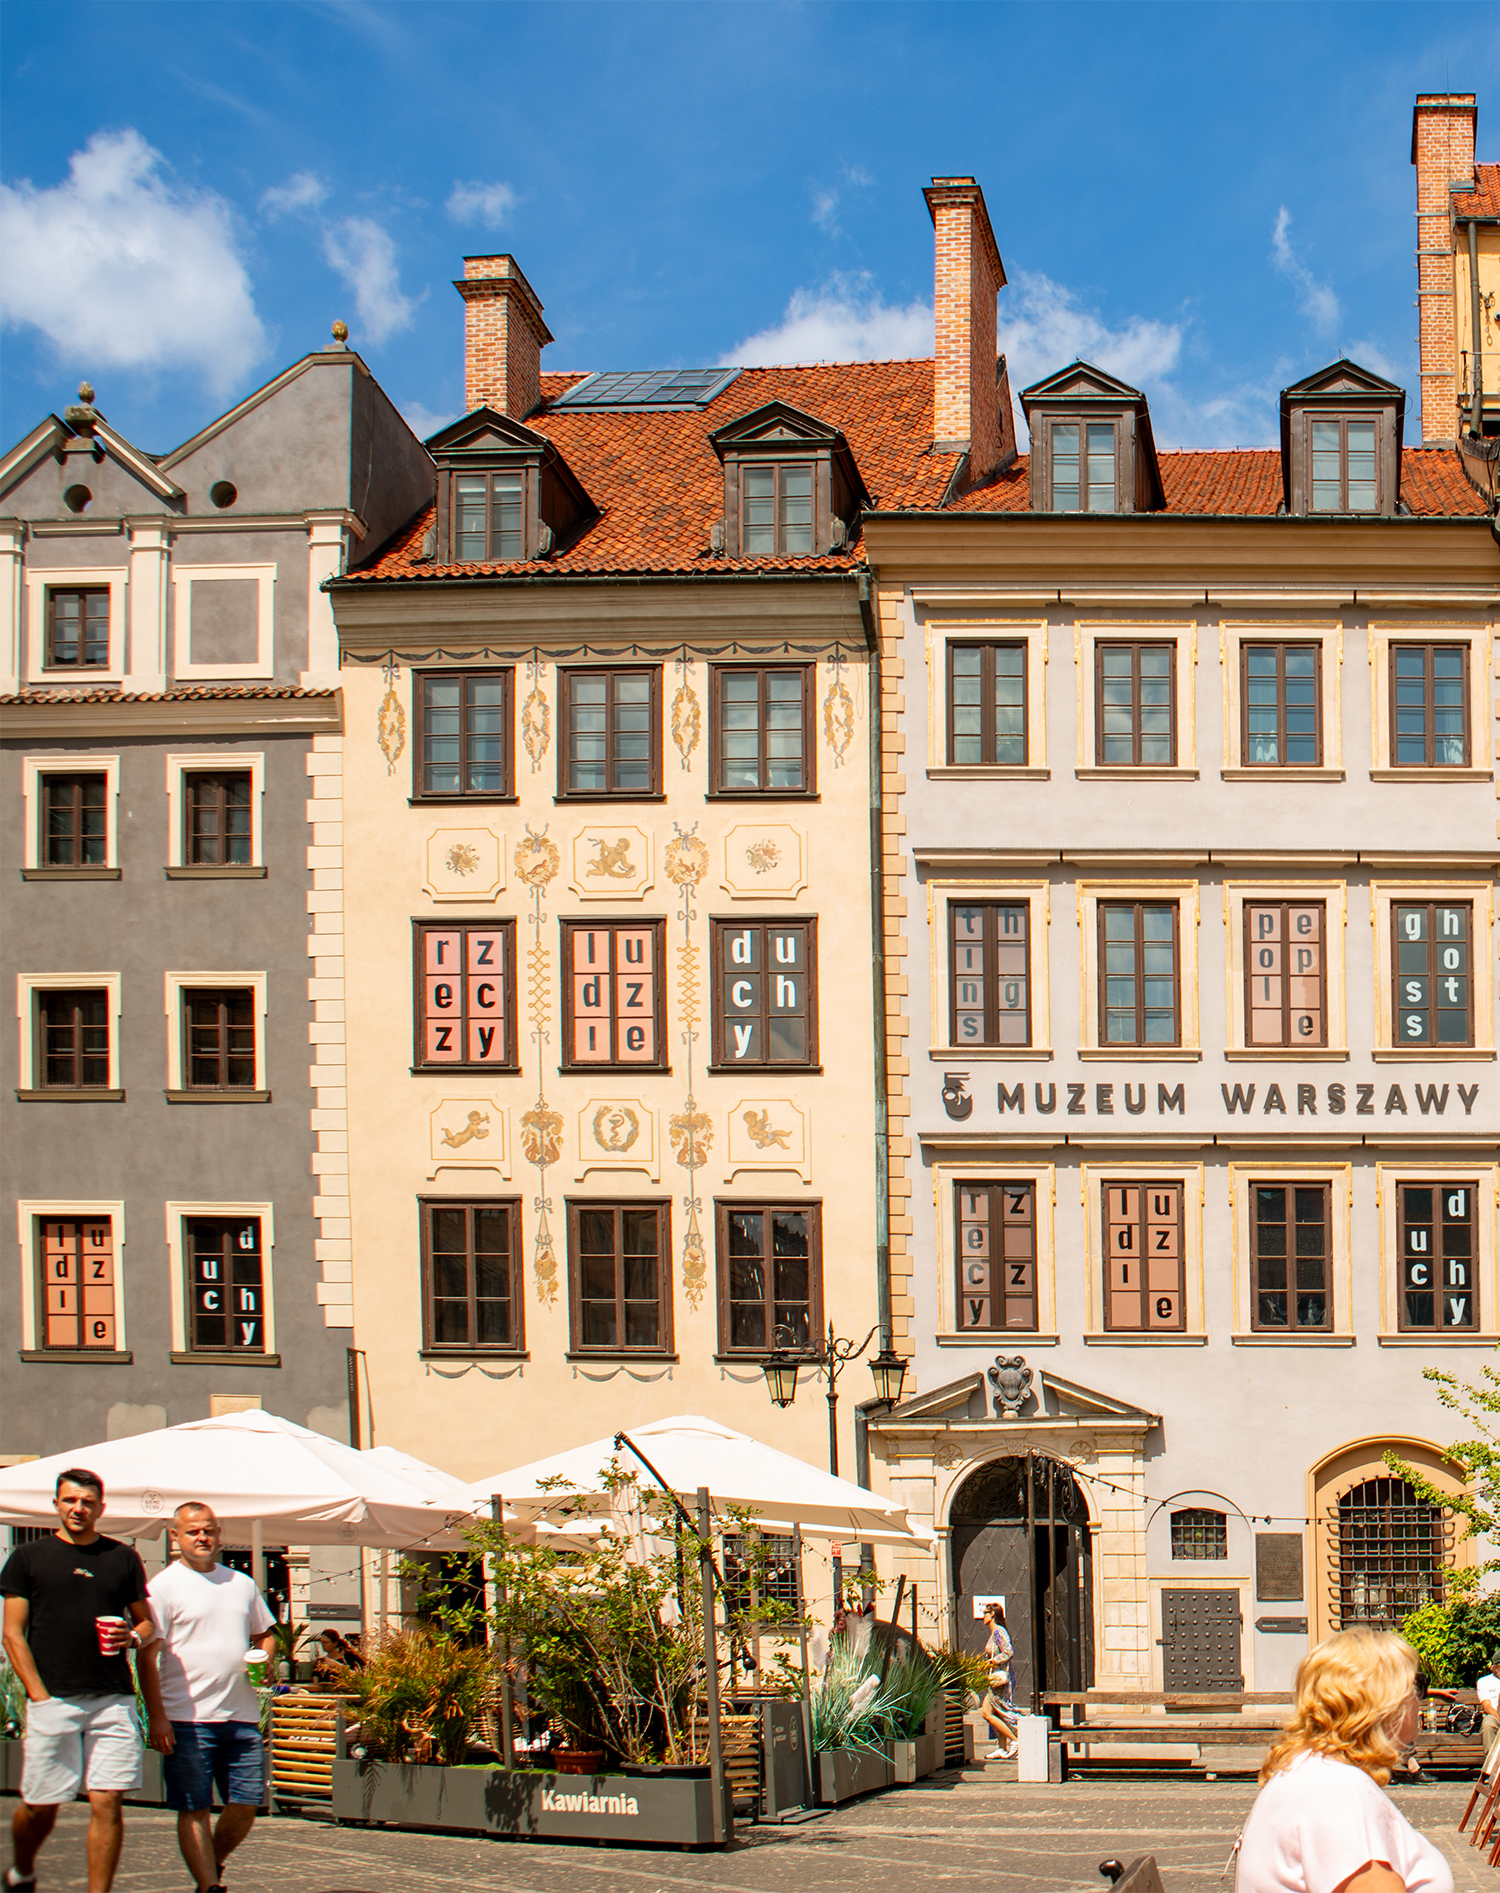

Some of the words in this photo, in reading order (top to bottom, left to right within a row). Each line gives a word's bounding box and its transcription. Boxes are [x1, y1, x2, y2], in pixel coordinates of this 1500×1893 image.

[997, 1082, 1186, 1115] MUZEUM
[1220, 1082, 1480, 1115] WARSZAWY
[541, 1789, 639, 1815] Kawiarnia
